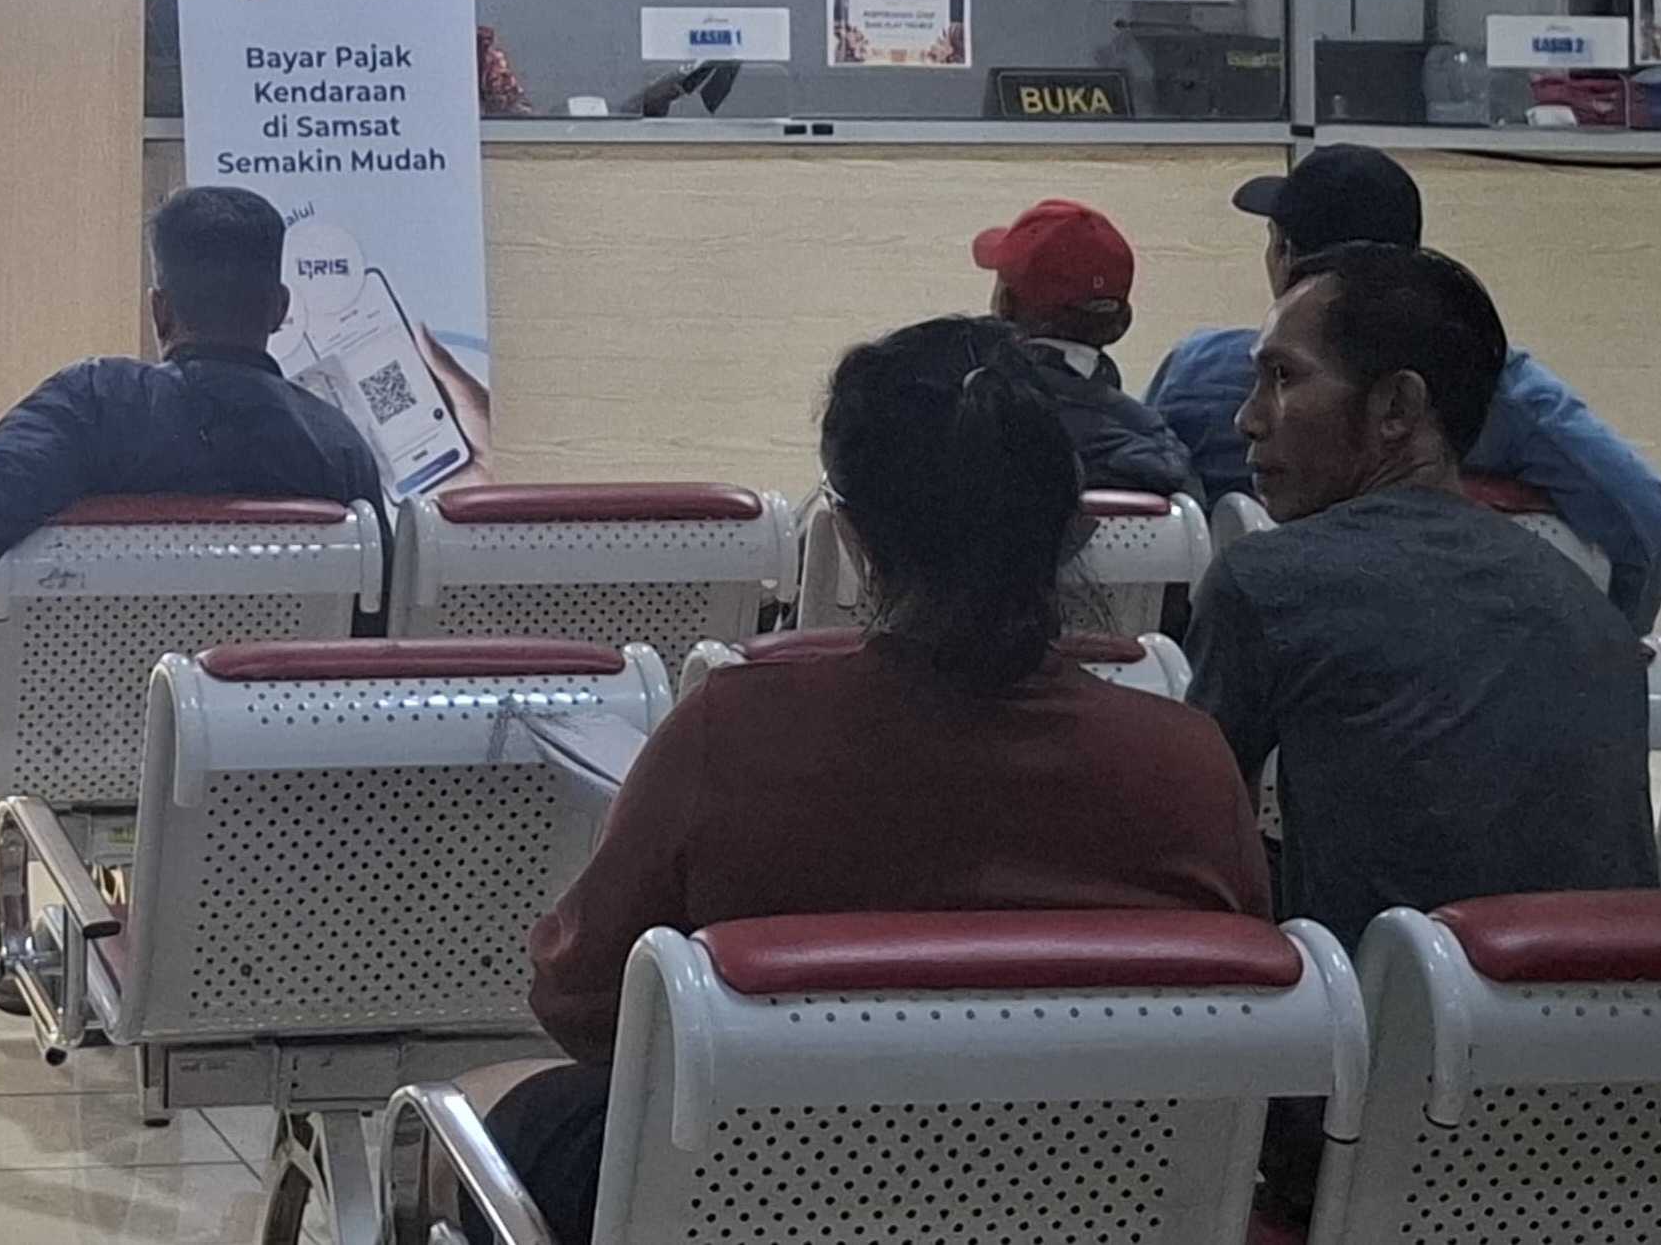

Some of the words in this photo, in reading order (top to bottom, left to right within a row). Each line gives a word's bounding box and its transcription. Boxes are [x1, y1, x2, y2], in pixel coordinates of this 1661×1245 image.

[689, 30, 732, 45] KASIR
[245, 47, 327, 77] Bayar
[336, 45, 412, 74] Pajak
[254, 80, 406, 104] Kendaraan
[1019, 86, 1113, 115] BUKA
[263, 114, 289, 139] di
[296, 114, 401, 138] Samsat
[217, 150, 343, 175] Semakin
[350, 149, 446, 174] Mudah
[298, 259, 350, 280] QRIS
